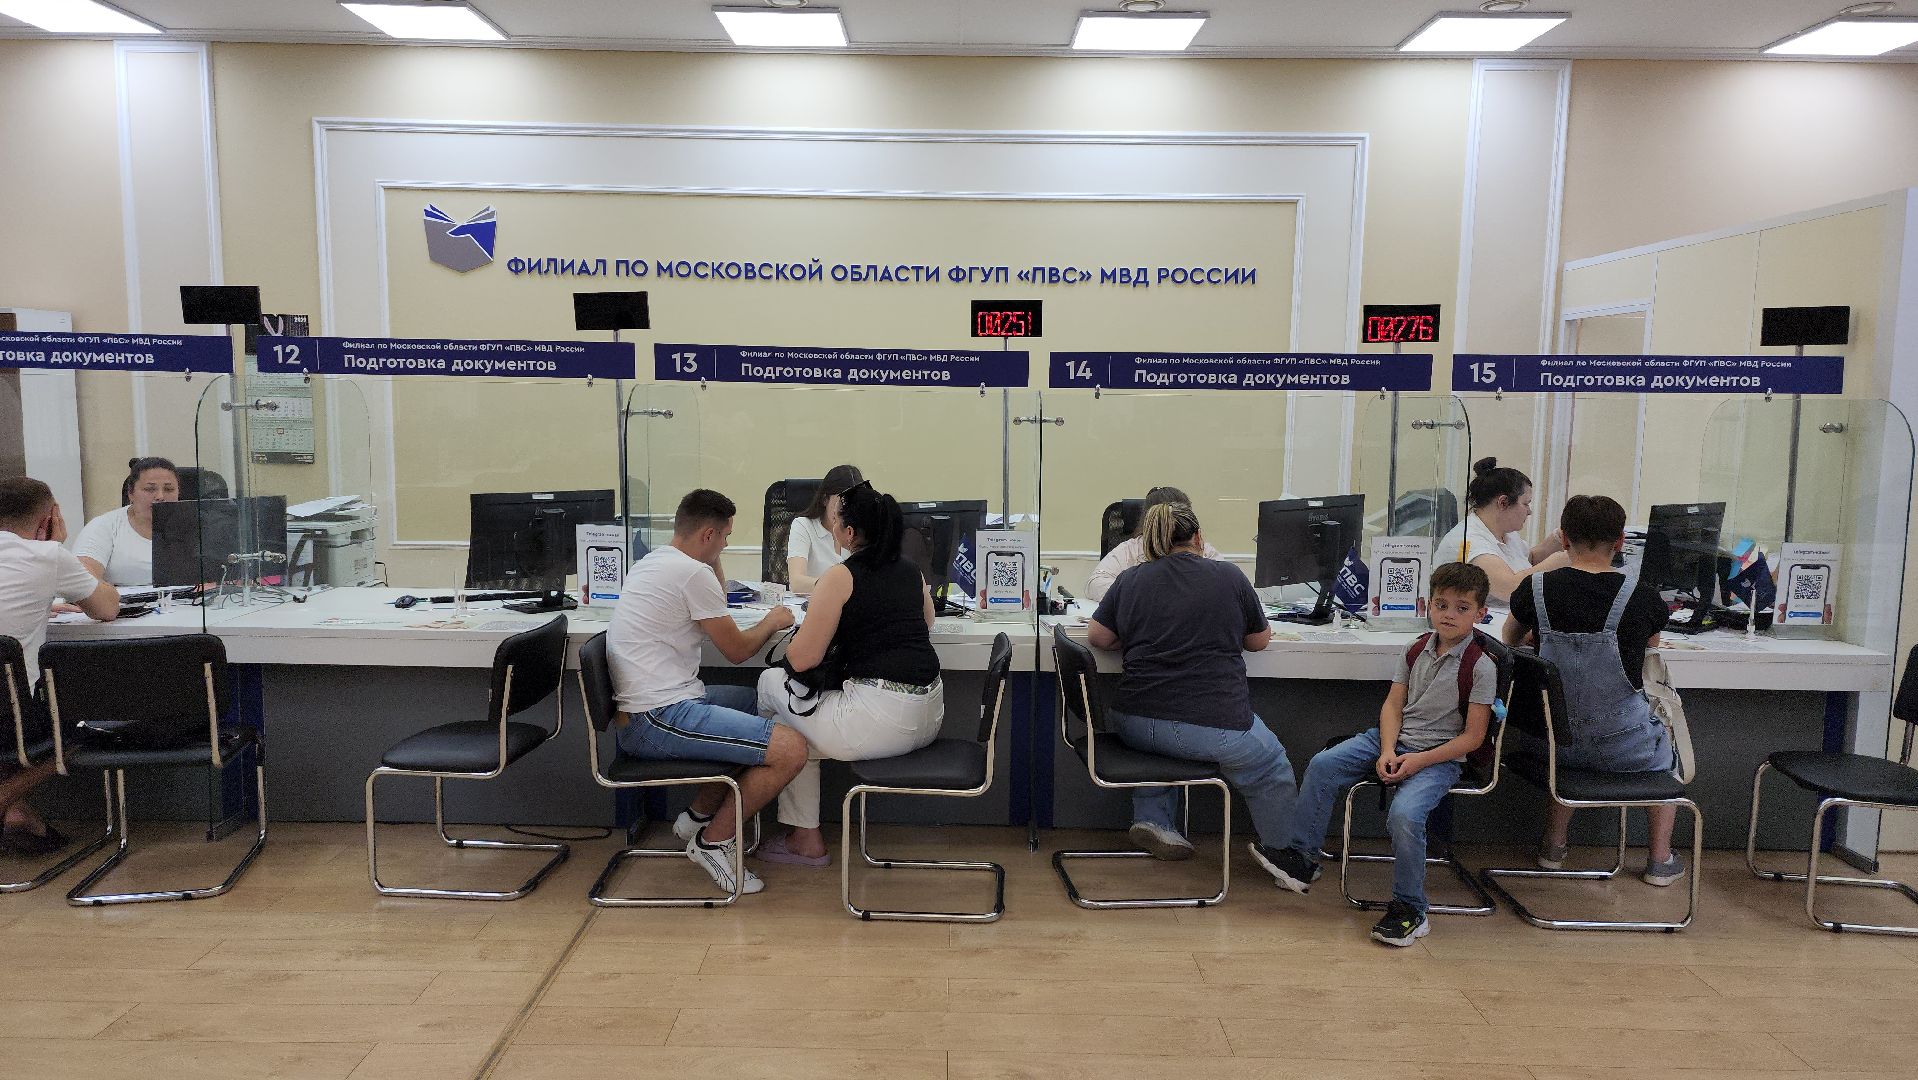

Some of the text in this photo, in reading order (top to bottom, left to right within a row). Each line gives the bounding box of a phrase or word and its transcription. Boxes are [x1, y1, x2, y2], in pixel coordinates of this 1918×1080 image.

[507, 256, 1257, 288] ФИЛИАЛ ПО МОСКОВСКОЙ ОБЛАСТИ ФГУП «ПВС» МВД РОССИИ
[42, 335, 76, 344] области
[77, 336, 101, 344] ФГУП
[132, 338, 151, 347] МВД
[152, 338, 183, 346] России
[342, 341, 375, 349] Филиал
[389, 341, 442, 350] Московской
[443, 342, 478, 351] области
[479, 344, 503, 352] ФГУП
[534, 345, 553, 354] МВД
[555, 345, 585, 353] России
[51, 351, 155, 366] документов
[273, 344, 301, 365] 12
[343, 354, 557, 374] Подготовка документов
[671, 352, 698, 373] 13
[739, 350, 773, 358] Филиал
[787, 351, 838, 360] Московской
[839, 352, 874, 361] области
[875, 353, 899, 361] ФГУП
[929, 354, 948, 363] МВД
[950, 354, 980, 362] России
[1134, 356, 1168, 364] Филиал
[1182, 356, 1234, 365] Московской
[1236, 357, 1271, 365] области
[1273, 357, 1297, 366] ФГУП
[1329, 358, 1348, 367] МВД
[1350, 358, 1381, 366] России
[1540, 358, 1574, 367] Филиал
[1588, 358, 1642, 367] Московской
[1644, 359, 1680, 367] области
[1682, 359, 1707, 367] ФГУП
[1739, 360, 1759, 369] МВД
[1760, 360, 1792, 368] России
[741, 362, 951, 382] Подготовка документов
[1065, 360, 1093, 380] 14
[1134, 369, 1351, 388] Подготовка документов
[1469, 362, 1497, 384] 15
[1540, 371, 1761, 390] Подготовка документов
[1339, 566, 1366, 596] ПВС
